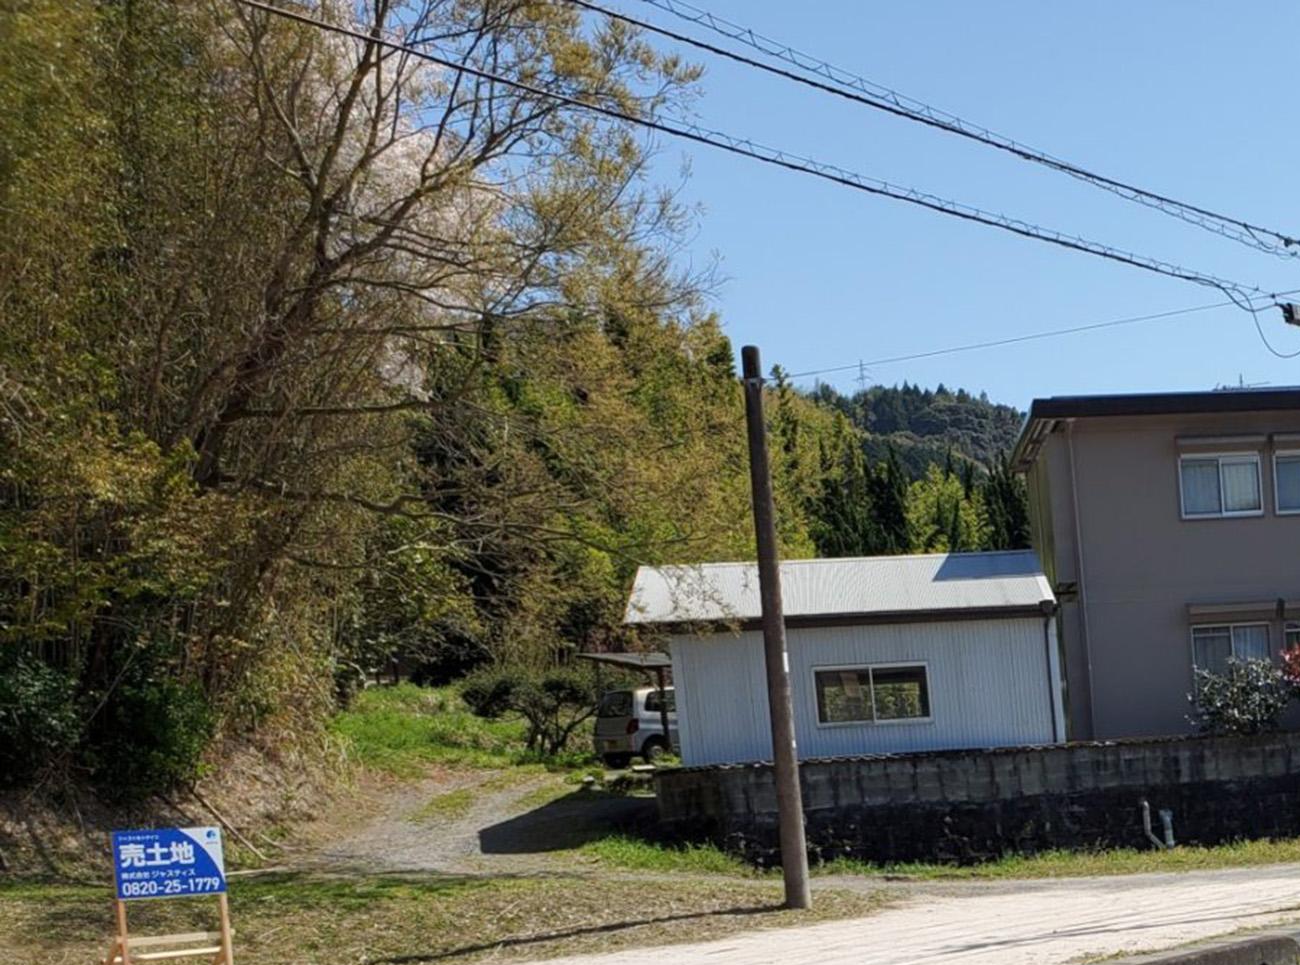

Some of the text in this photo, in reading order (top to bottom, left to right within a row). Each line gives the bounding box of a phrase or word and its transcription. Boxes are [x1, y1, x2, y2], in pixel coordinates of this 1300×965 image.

[119, 840, 195, 868] 売土地
[122, 877, 220, 896] 0820-25-1779
